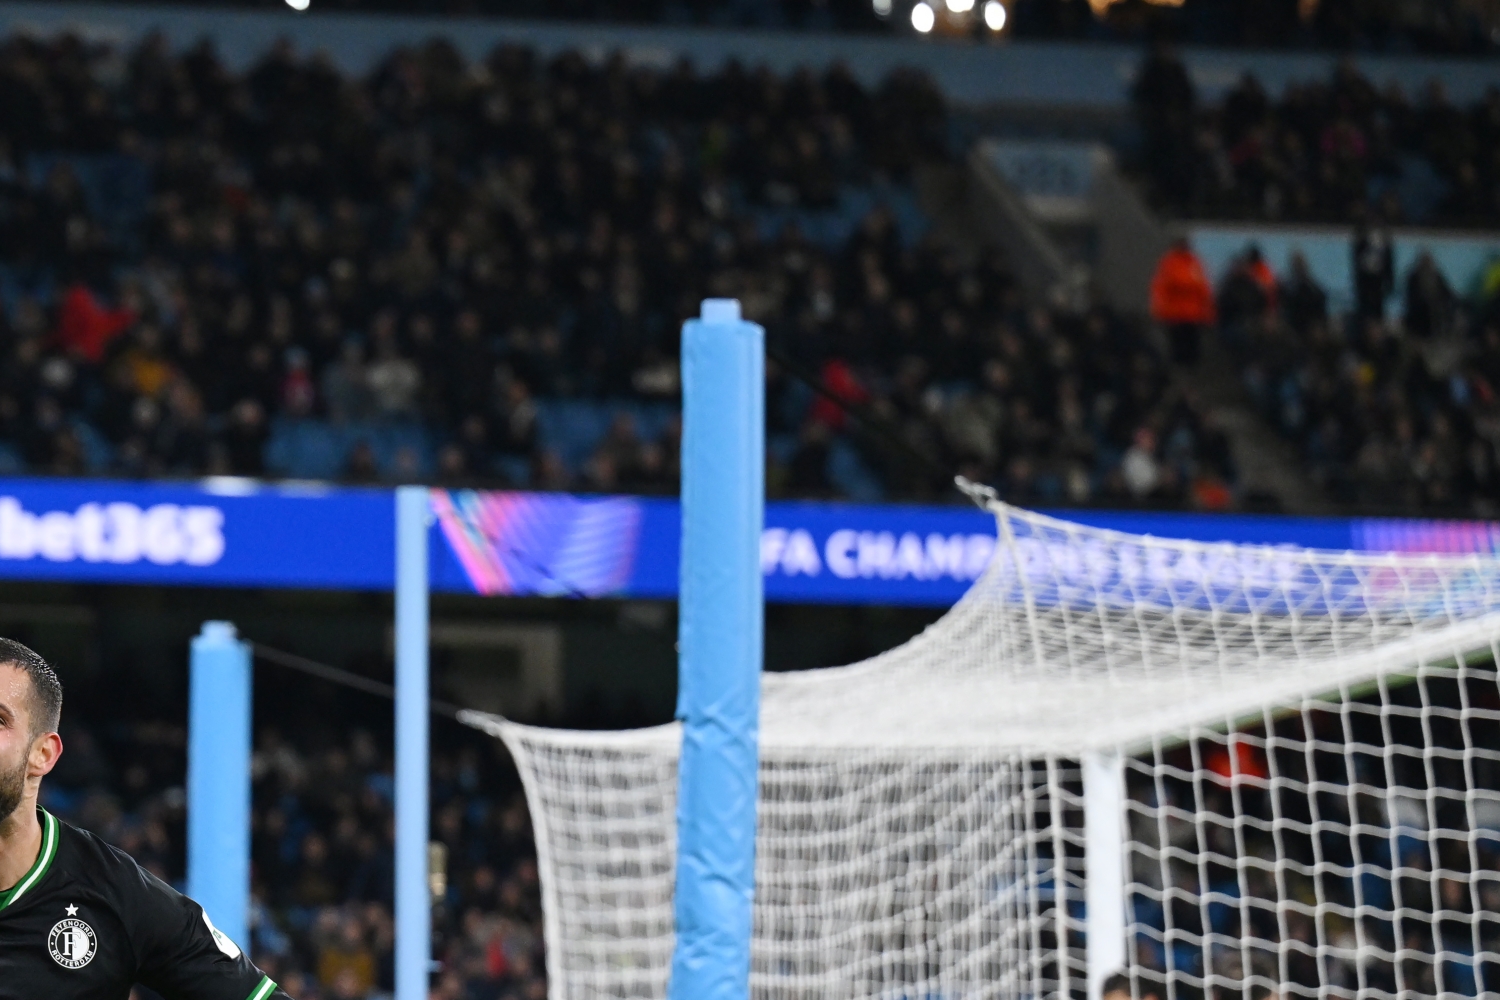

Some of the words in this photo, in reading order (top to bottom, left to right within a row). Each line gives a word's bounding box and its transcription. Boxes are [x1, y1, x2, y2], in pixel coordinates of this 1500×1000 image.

[759, 527, 822, 578] FA
[51, 920, 93, 938] FEYENOORD
[51, 949, 94, 967] ROTTERDAM
